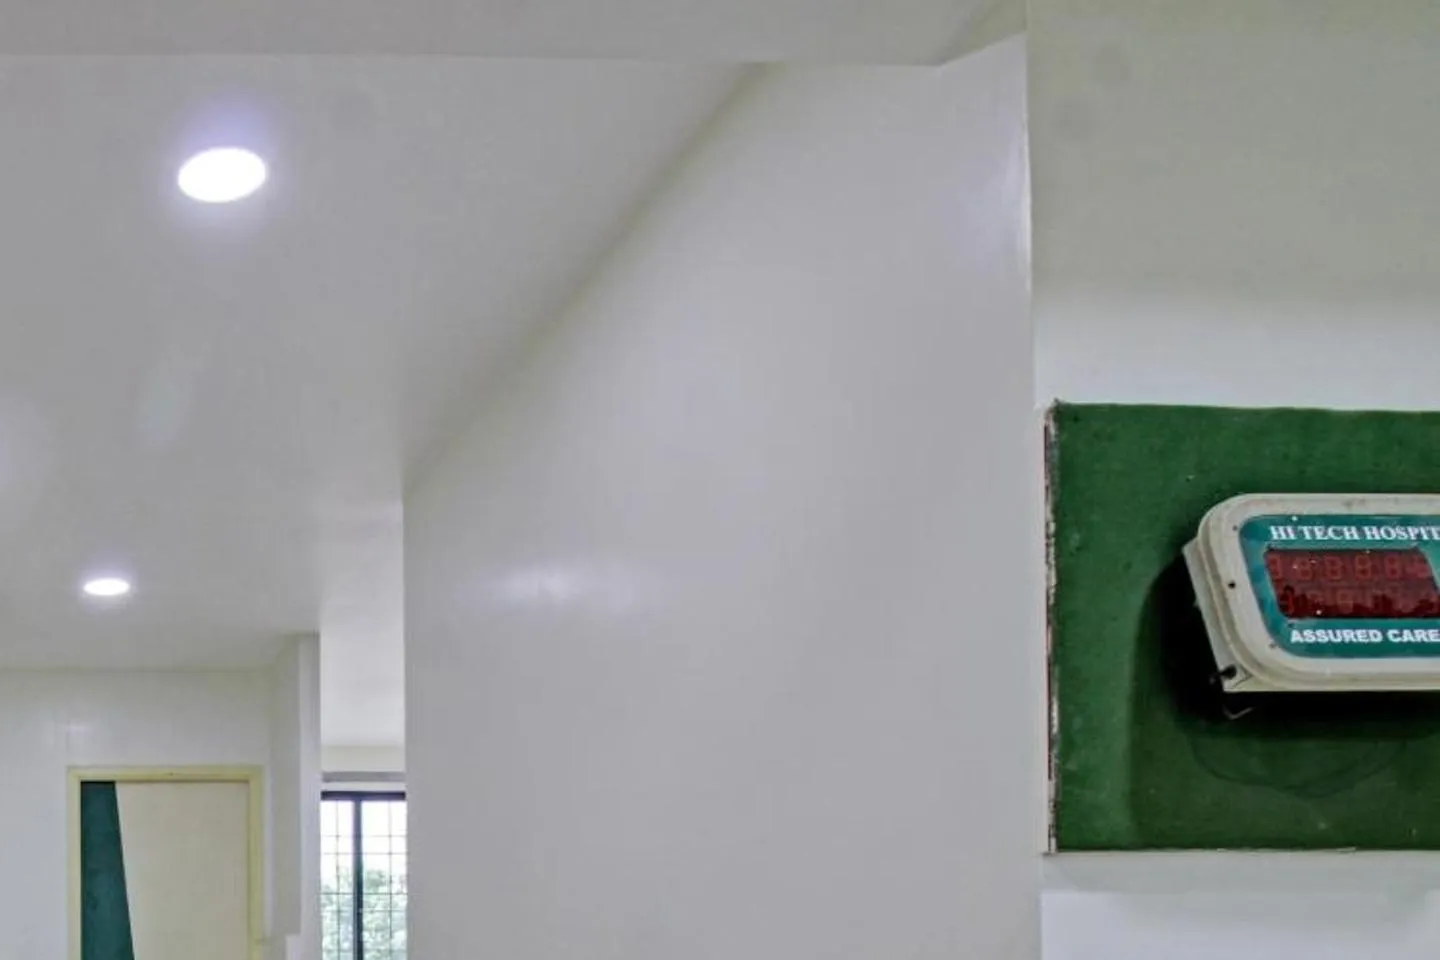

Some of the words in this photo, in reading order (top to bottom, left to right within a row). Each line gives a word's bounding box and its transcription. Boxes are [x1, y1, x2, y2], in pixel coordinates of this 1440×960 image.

[1270, 525, 1295, 541] HI
[1300, 525, 1360, 541] TECH
[1290, 629, 1383, 643] ASSURED
[1387, 629, 1440, 643] CARE
